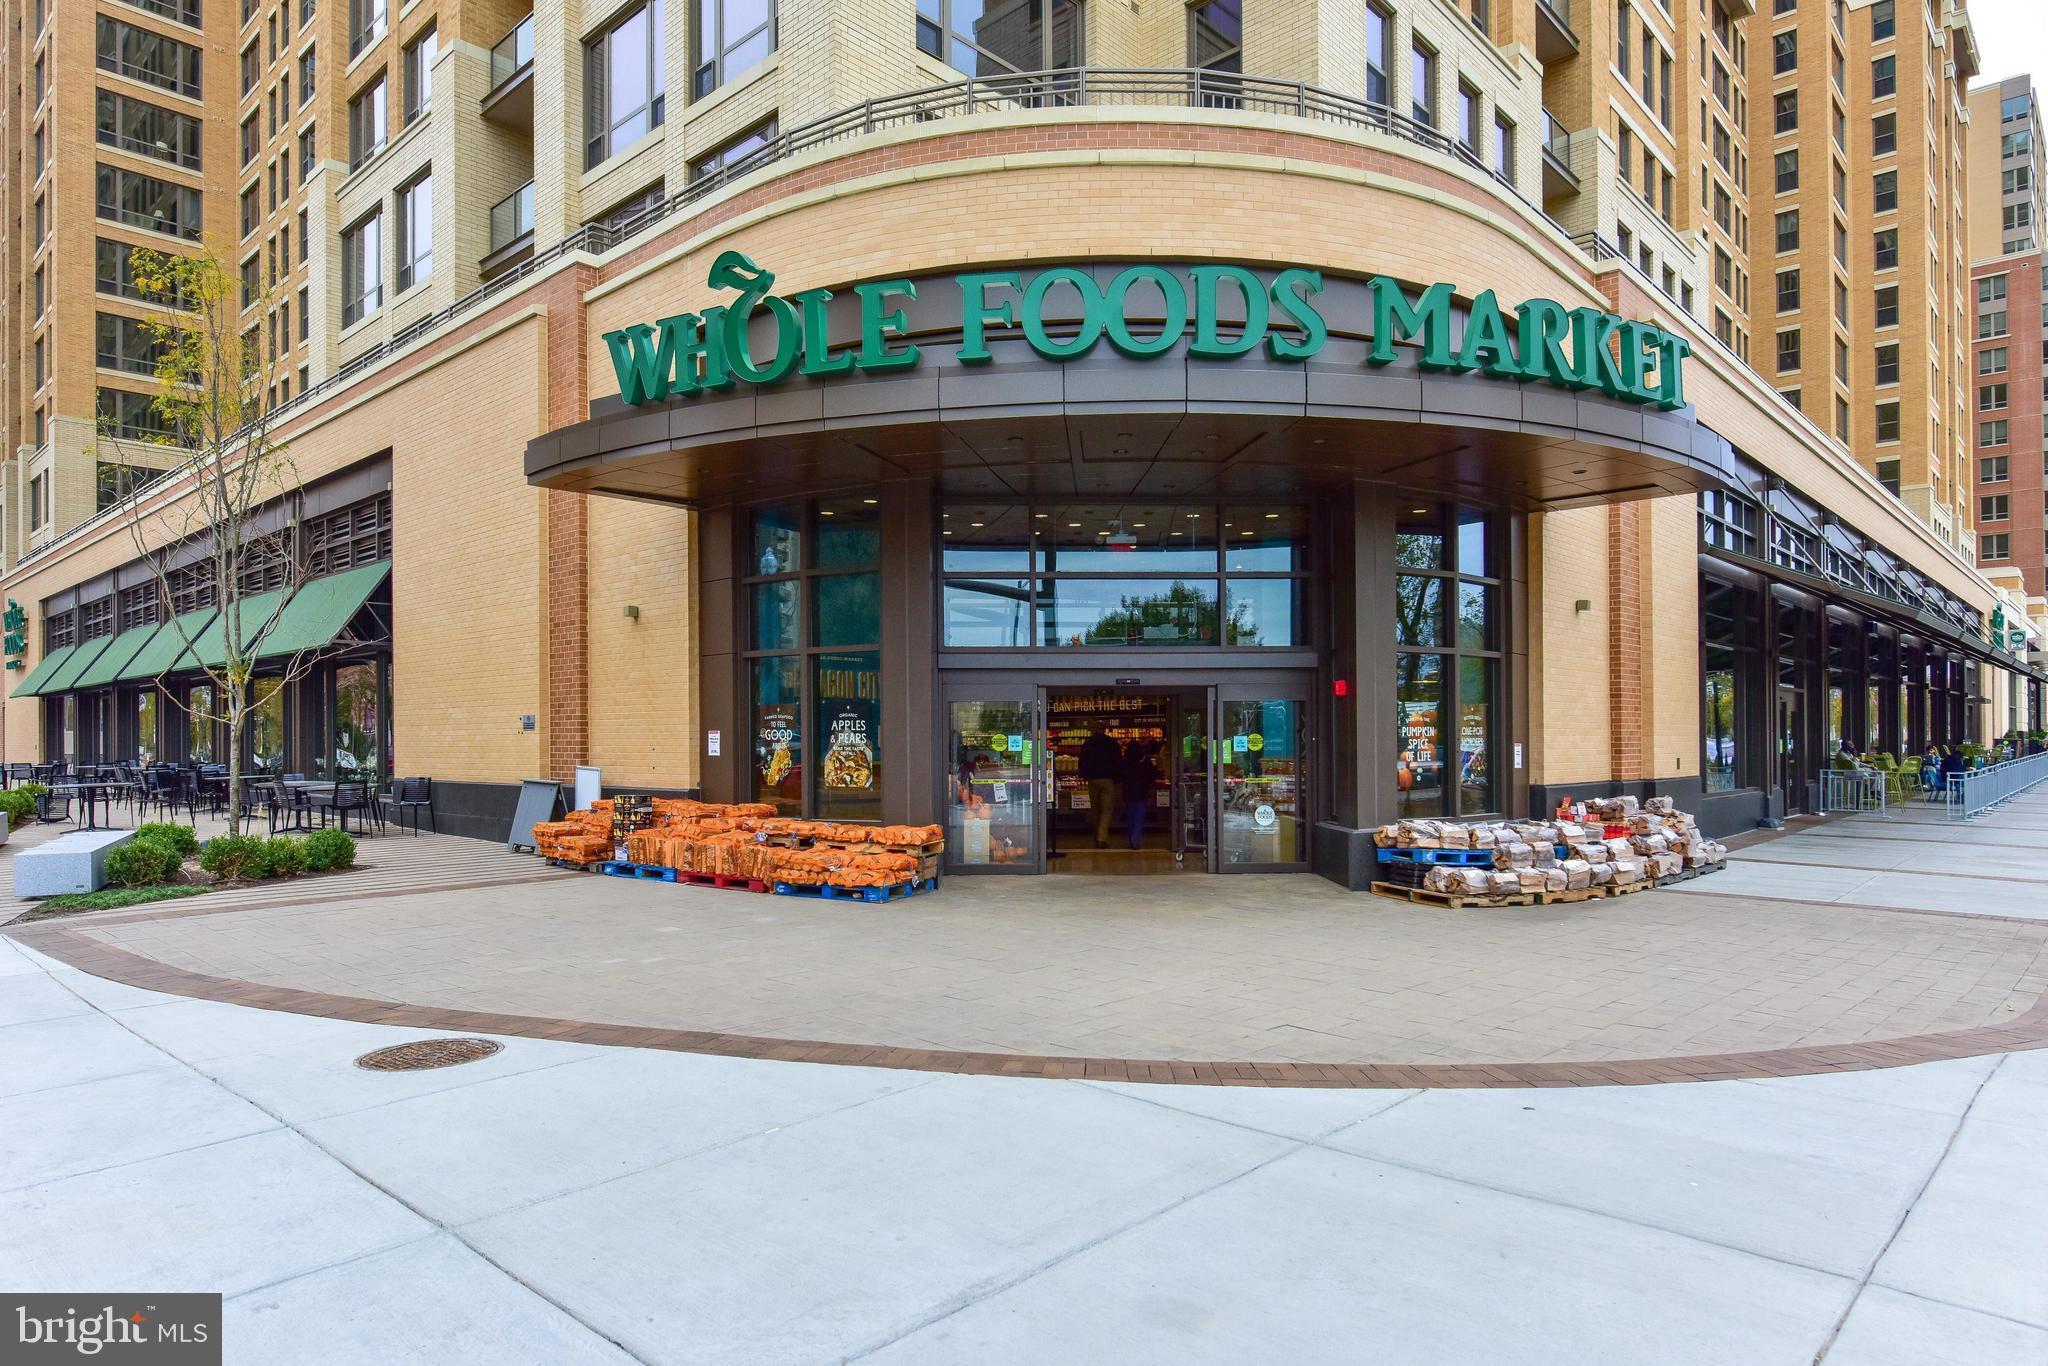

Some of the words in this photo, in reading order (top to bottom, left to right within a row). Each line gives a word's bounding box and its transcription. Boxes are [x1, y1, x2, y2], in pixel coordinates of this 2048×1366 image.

[602, 251, 919, 406] WHOLE
[956, 264, 1328, 364] FOODS
[1367, 275, 1691, 412] MARKET
[1098, 700, 1118, 711] THE
[831, 720, 866, 731] APPLES
[765, 729, 793, 741] GOOD
[1402, 727, 1435, 737] PUMPKIN
[830, 735, 836, 743] &
[838, 733, 867, 744] PEARS
[1408, 738, 1429, 749] SPICE
[1406, 751, 1415, 762] OF
[1417, 751, 1432, 762] LIFE
